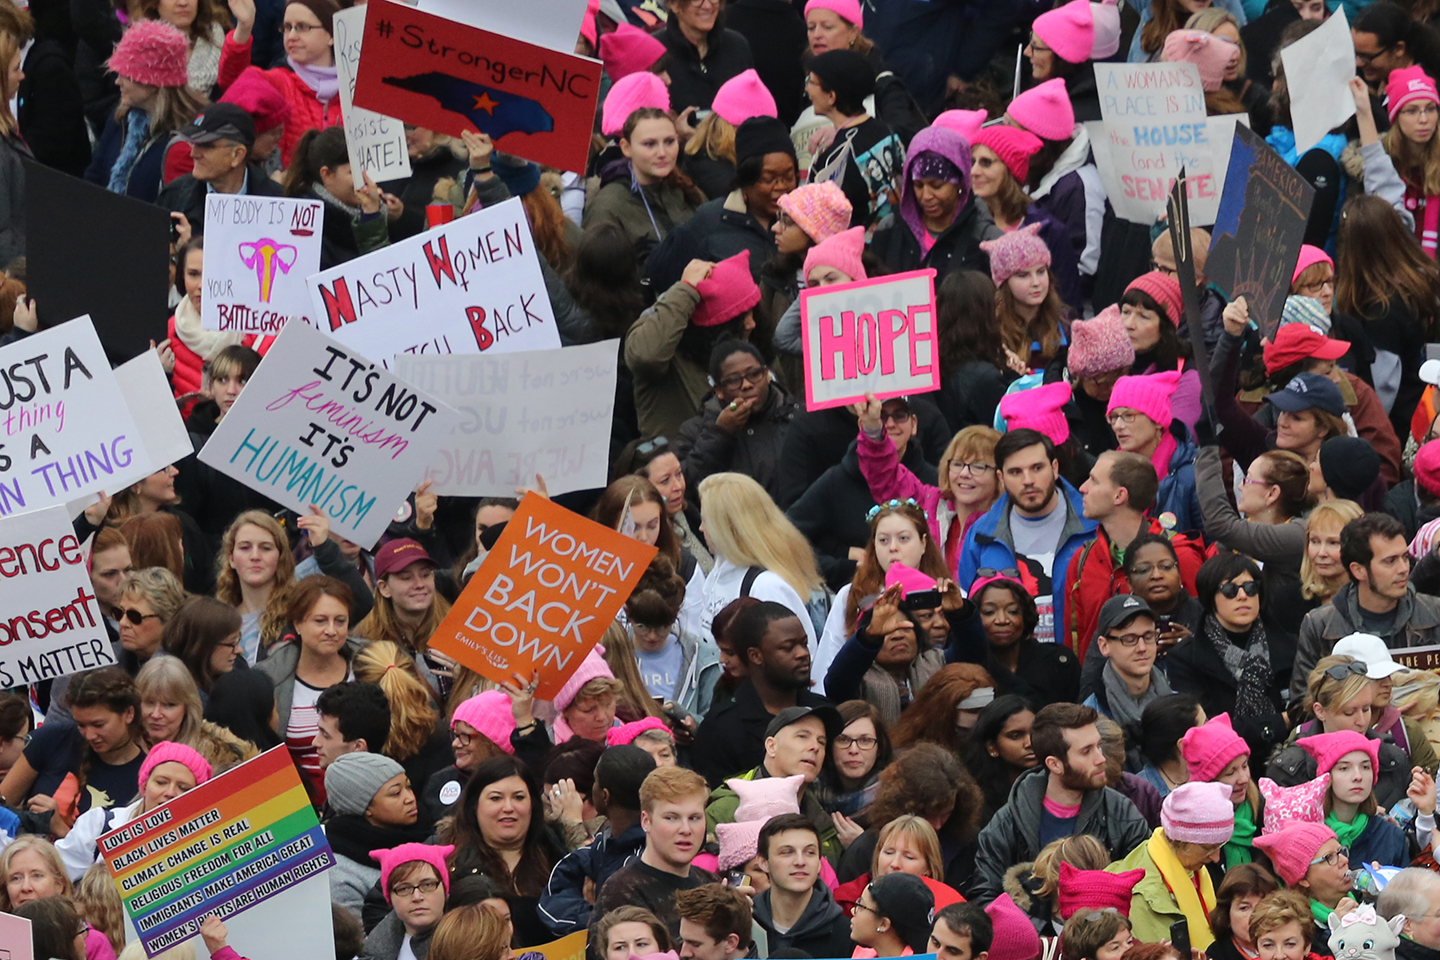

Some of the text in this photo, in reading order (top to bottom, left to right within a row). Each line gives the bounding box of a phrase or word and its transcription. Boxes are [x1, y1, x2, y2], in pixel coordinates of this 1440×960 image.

[375, 19, 592, 99] #StrongerNC
[1124, 68, 1194, 89] WOMAN'S
[1104, 96, 1157, 116] PLACE
[1132, 123, 1208, 146] HOUSE
[207, 199, 320, 231] MY BODY IS NOT
[208, 278, 234, 299] YOUR
[318, 222, 525, 332] NASTY WOMEN
[465, 293, 544, 352] BACK
[819, 304, 934, 381] HOPE
[2, 400, 66, 436] thing
[265, 380, 409, 460] feminism
[313, 345, 381, 403] IT'S
[374, 382, 437, 432] NOT
[31, 434, 134, 497] THING
[298, 422, 355, 468] IT'S
[229, 428, 377, 531] HUMANISM
[509, 544, 617, 608] WON'T
[525, 515, 634, 582] WOMEN
[464, 606, 573, 671] DOWN
[483, 573, 595, 644] BACK
[18, 639, 114, 682] MATTER
[455, 631, 488, 654] EMILY'S
[103, 808, 172, 851] LOVE IS LOVE
[112, 808, 220, 871] BLACK LIVES MATTER
[121, 819, 250, 891] CLIMATE CHANGE IS REAL
